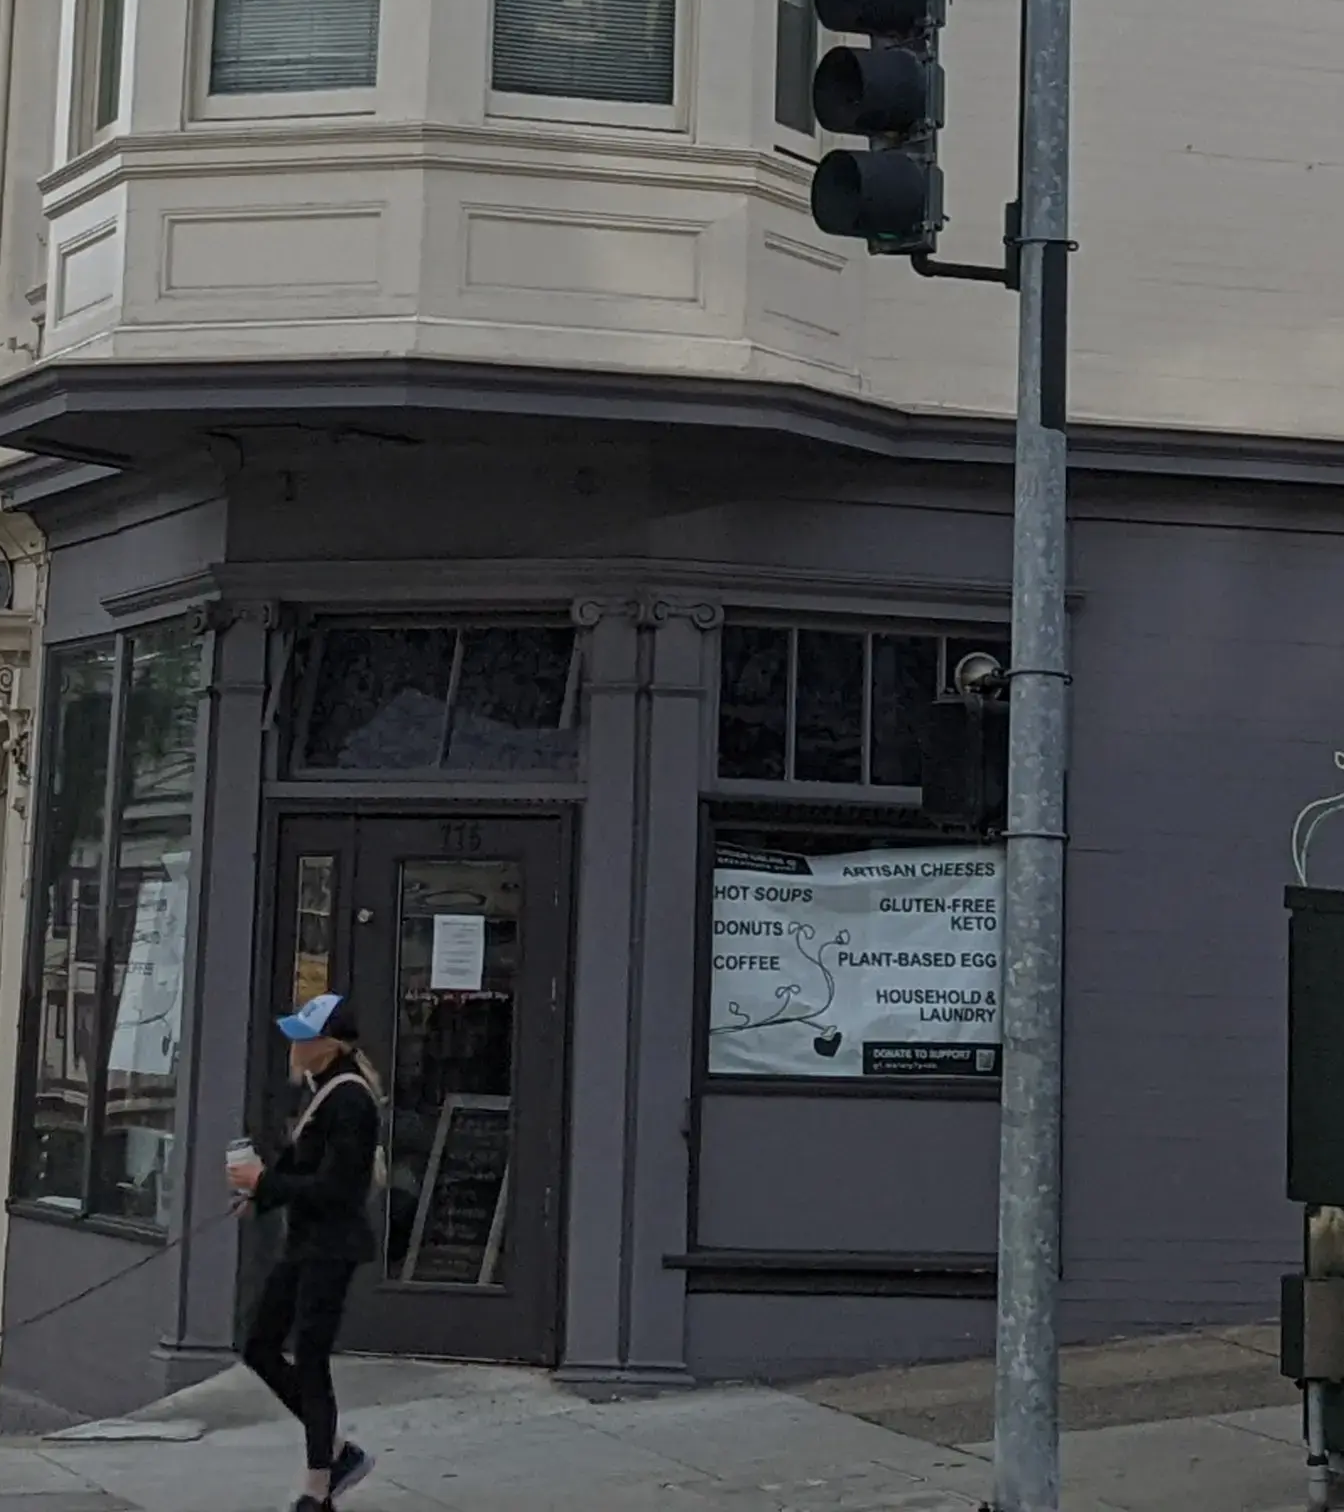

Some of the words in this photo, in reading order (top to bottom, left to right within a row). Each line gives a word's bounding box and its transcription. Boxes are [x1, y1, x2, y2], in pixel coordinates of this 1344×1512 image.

[842, 864, 916, 878] ARTISAN
[920, 862, 996, 877] CHEESES
[713, 886, 750, 902] HOT
[754, 887, 813, 903] SOUPS
[879, 898, 996, 913] GLUTEN-FREE
[713, 921, 784, 936] DONUTS
[950, 916, 997, 931] KETO
[713, 955, 781, 971] COFFEE
[837, 952, 956, 967] PLANT-BASED
[960, 952, 997, 968] EGG
[876, 989, 982, 1004] HOUSEHOLD
[985, 990, 997, 1005] &
[920, 1007, 996, 1022] LAUNDRY
